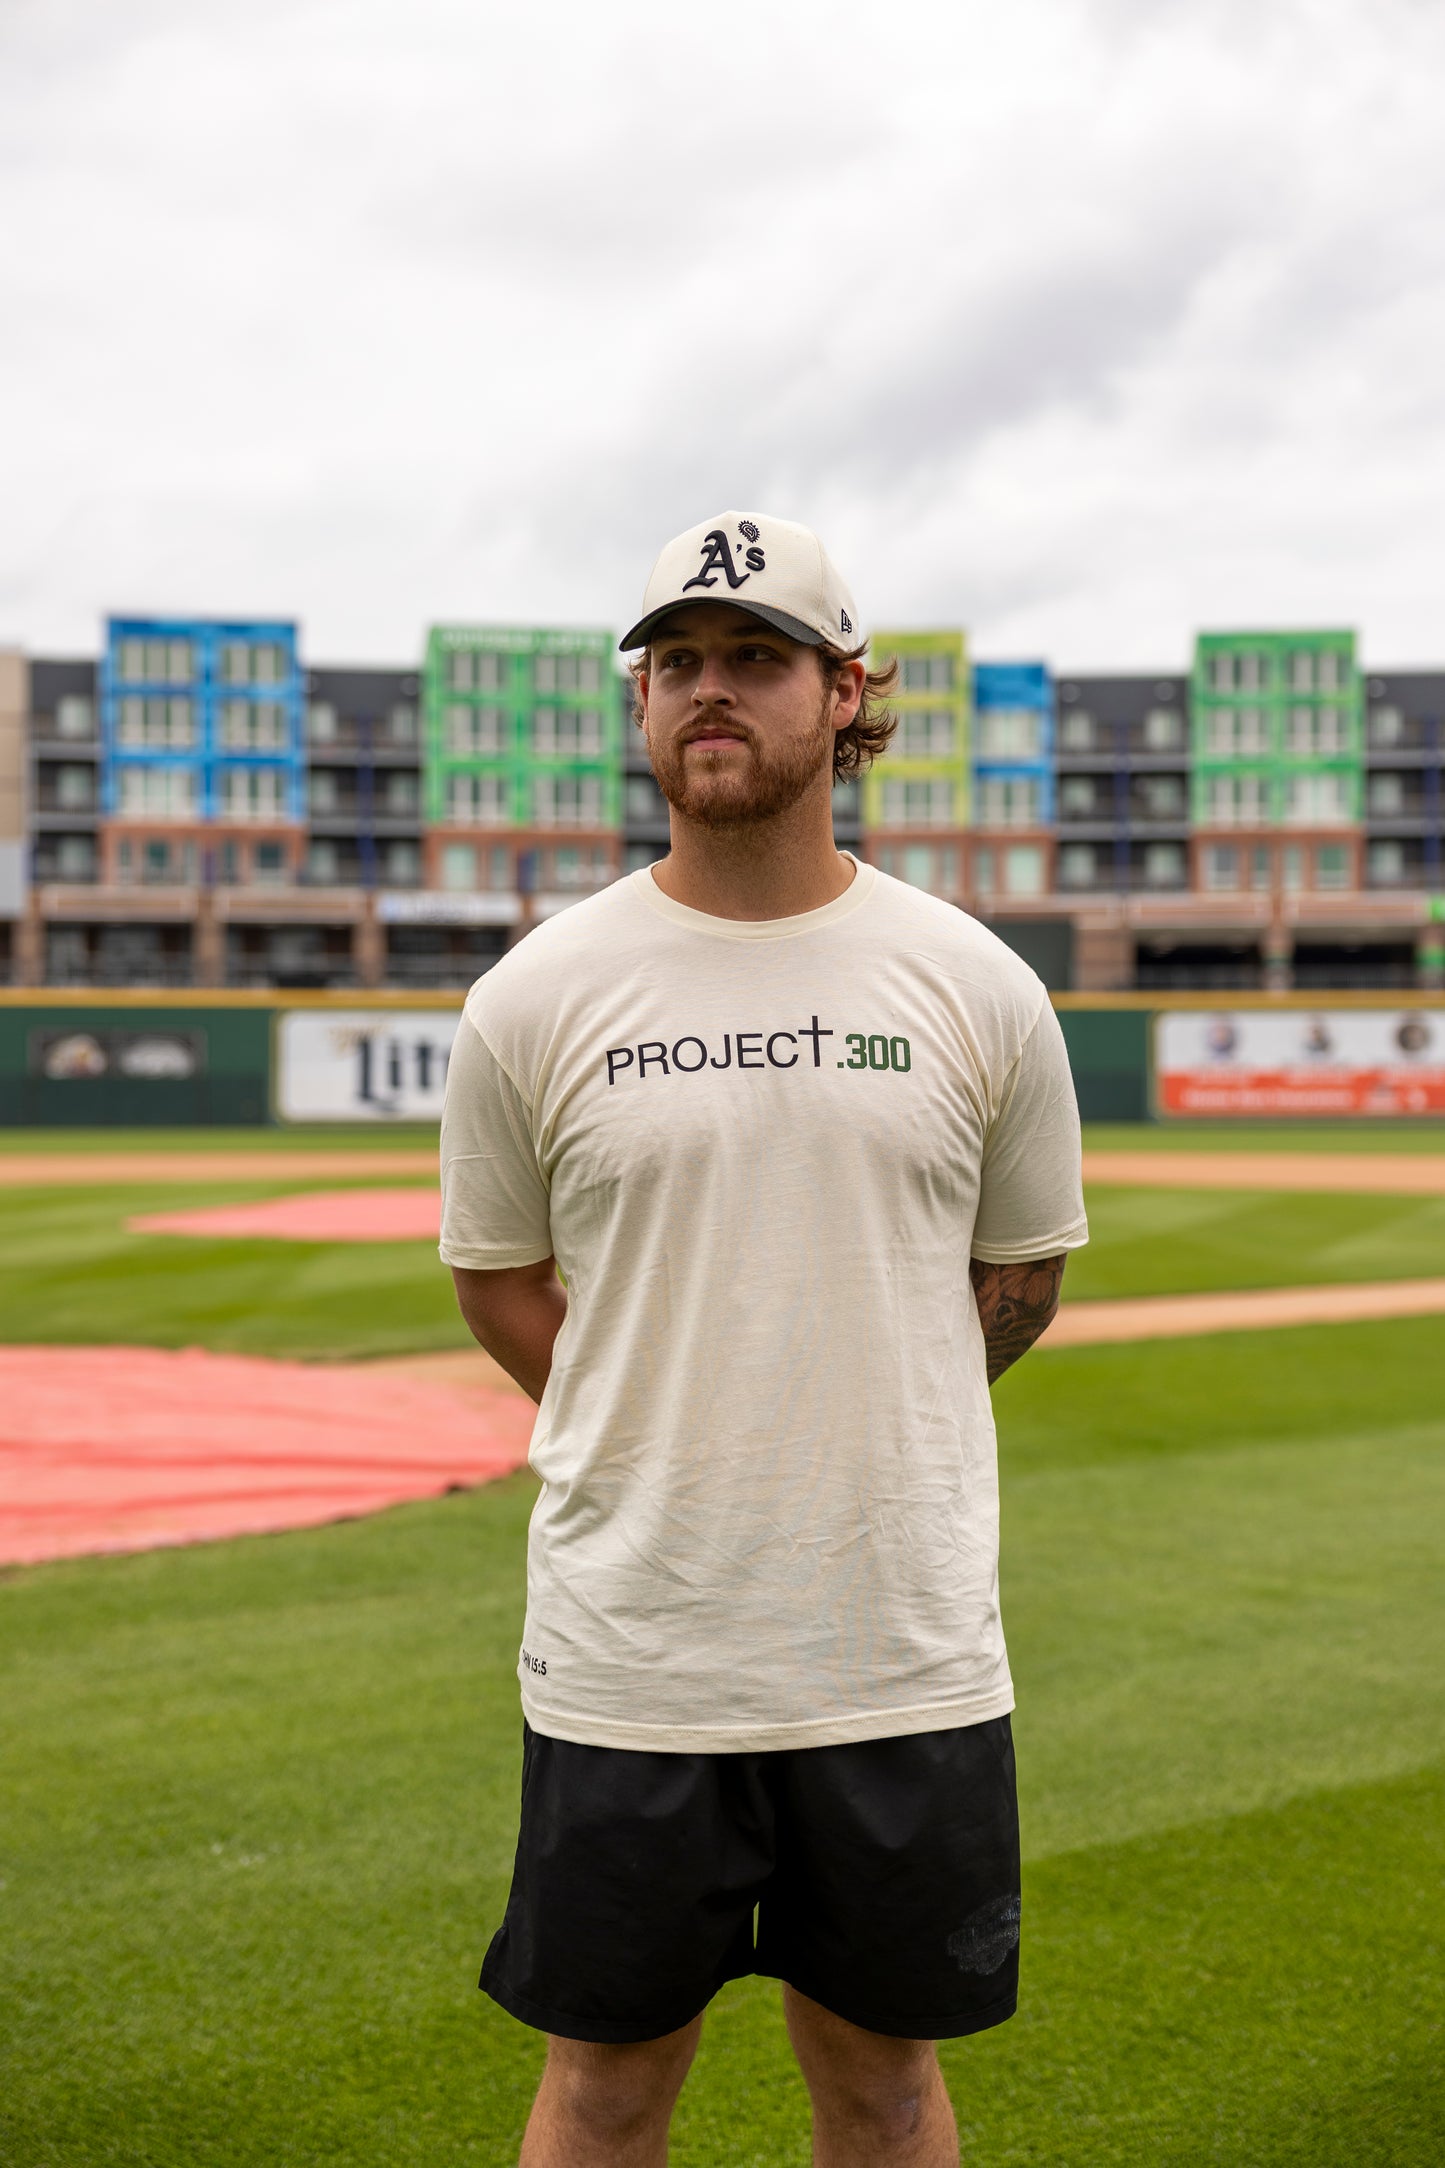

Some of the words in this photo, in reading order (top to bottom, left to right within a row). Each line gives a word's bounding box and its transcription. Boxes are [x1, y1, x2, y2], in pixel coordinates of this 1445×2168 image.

[682, 529, 766, 592] A's
[354, 1032, 450, 1112] Lit
[836, 1033, 911, 1073] .300
